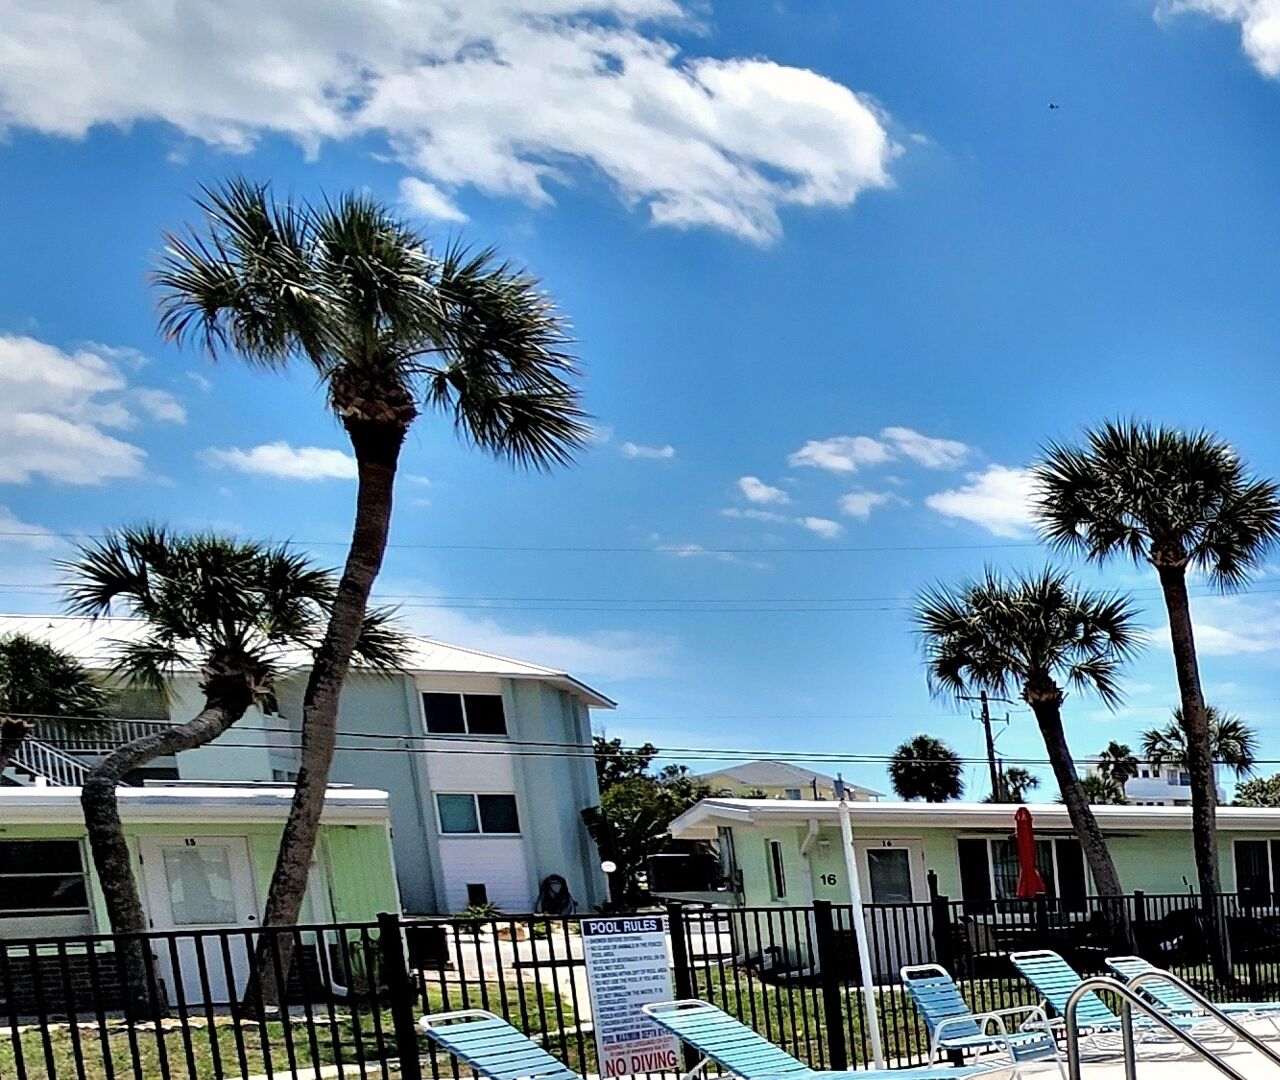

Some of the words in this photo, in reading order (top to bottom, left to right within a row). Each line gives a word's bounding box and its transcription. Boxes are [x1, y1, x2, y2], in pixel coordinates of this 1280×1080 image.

[820, 874, 837, 885] 16
[590, 922, 621, 934] POOL
[623, 920, 657, 932] RULES
[605, 1058, 627, 1077] NO
[631, 1050, 677, 1073] DIVING
